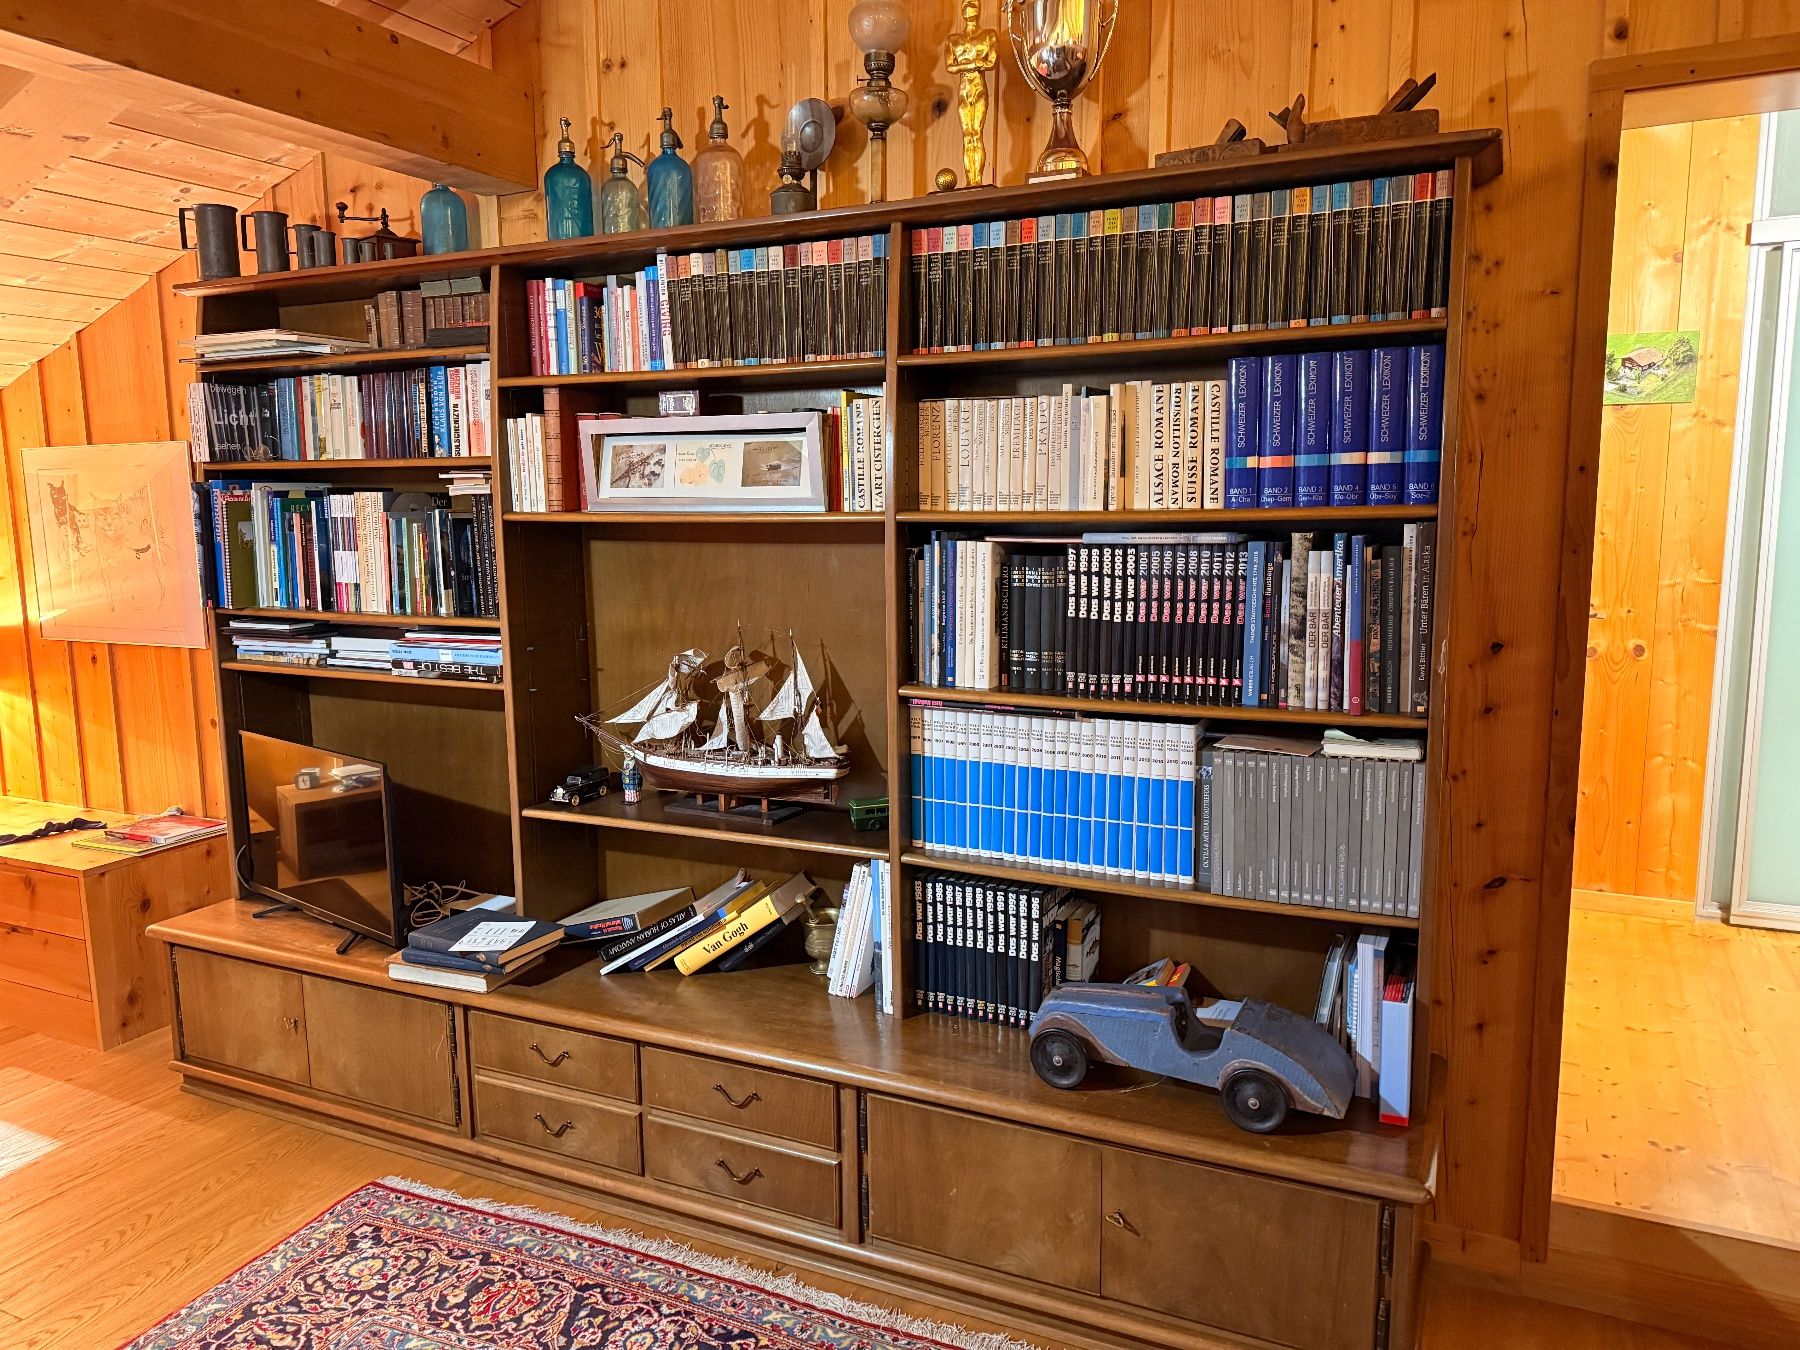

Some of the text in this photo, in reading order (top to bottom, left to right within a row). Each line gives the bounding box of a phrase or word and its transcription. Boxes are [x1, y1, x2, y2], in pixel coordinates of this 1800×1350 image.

[661, 300, 671, 337] GIVING
[210, 385, 246, 395] bewegen
[1308, 361, 1317, 445] SCHWEIZER LEXIKON
[1343, 356, 1353, 443] SCHWEIZER LEXIKON
[1381, 355, 1391, 442] SCHWEIZER LEXIKON
[1419, 352, 1430, 440] SCHWEIZER LEXIKON
[213, 408, 258, 425] Licht
[1273, 362, 1282, 447] SCHWEIZER LEXIKON
[932, 405, 941, 461] FLORENZ
[961, 405, 970, 467] LOUVRE
[1012, 401, 1021, 459] EREMITAGE
[873, 400, 883, 509] L'ART CISTERCIEN
[1154, 386, 1164, 506] ALSACE ROMANE
[1171, 388, 1181, 505] ROUSSILLON ROMAN
[1187, 385, 1199, 502] SUISSE ROMANE
[1210, 384, 1220, 503] CASTILLE ROMANE
[857, 458, 865, 509] CASTILLE
[432, 496, 447, 507] Der
[1068, 548, 1076, 571] 1997
[1080, 549, 1088, 572] 1998
[1103, 548, 1111, 574] 2000
[1127, 548, 1135, 575] 2003
[1213, 552, 1222, 575] 2011
[1225, 552, 1235, 576] 2012
[1423, 545, 1431, 571] Alaska
[1265, 562, 1273, 596] Hausberge
[1333, 539, 1344, 637] Abenteuer Amerika
[1079, 598, 1087, 618] Das
[1126, 601, 1134, 621] Das
[1211, 602, 1219, 623] Das
[1223, 603, 1231, 624] Das
[1309, 611, 1317, 629] BÄR
[1321, 611, 1330, 649] DER BÄR
[1420, 611, 1428, 634] Unter
[434, 664, 461, 673] BEST
[464, 666, 485, 675] THE
[661, 921, 668, 930] OF
[669, 912, 685, 926] ATLAS
[609, 937, 636, 955] ANATOMY
[637, 926, 659, 941] HUMAN
[702, 921, 749, 956] Van Gogh
[1019, 939, 1027, 959] Das
[1031, 942, 1039, 961] Das
